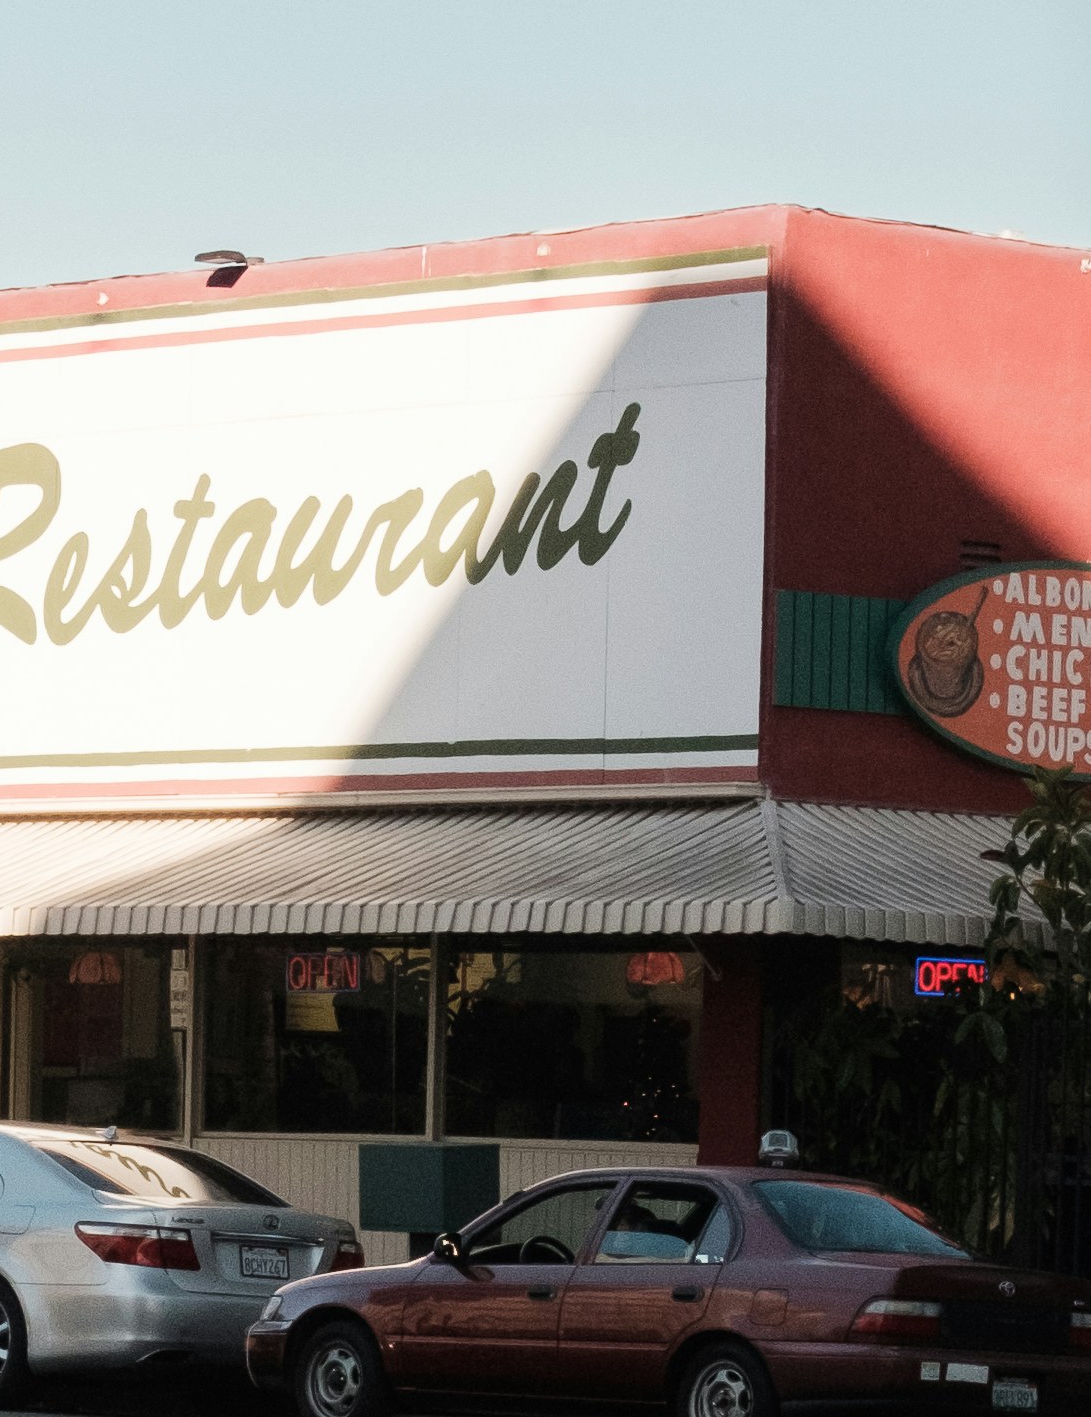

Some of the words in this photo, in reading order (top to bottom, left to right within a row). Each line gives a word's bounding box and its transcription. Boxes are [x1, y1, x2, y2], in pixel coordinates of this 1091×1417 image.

[1006, 684, 1087, 723] BEEF
[289, 953, 357, 989] OPEN
[918, 961, 985, 992] OPEN
